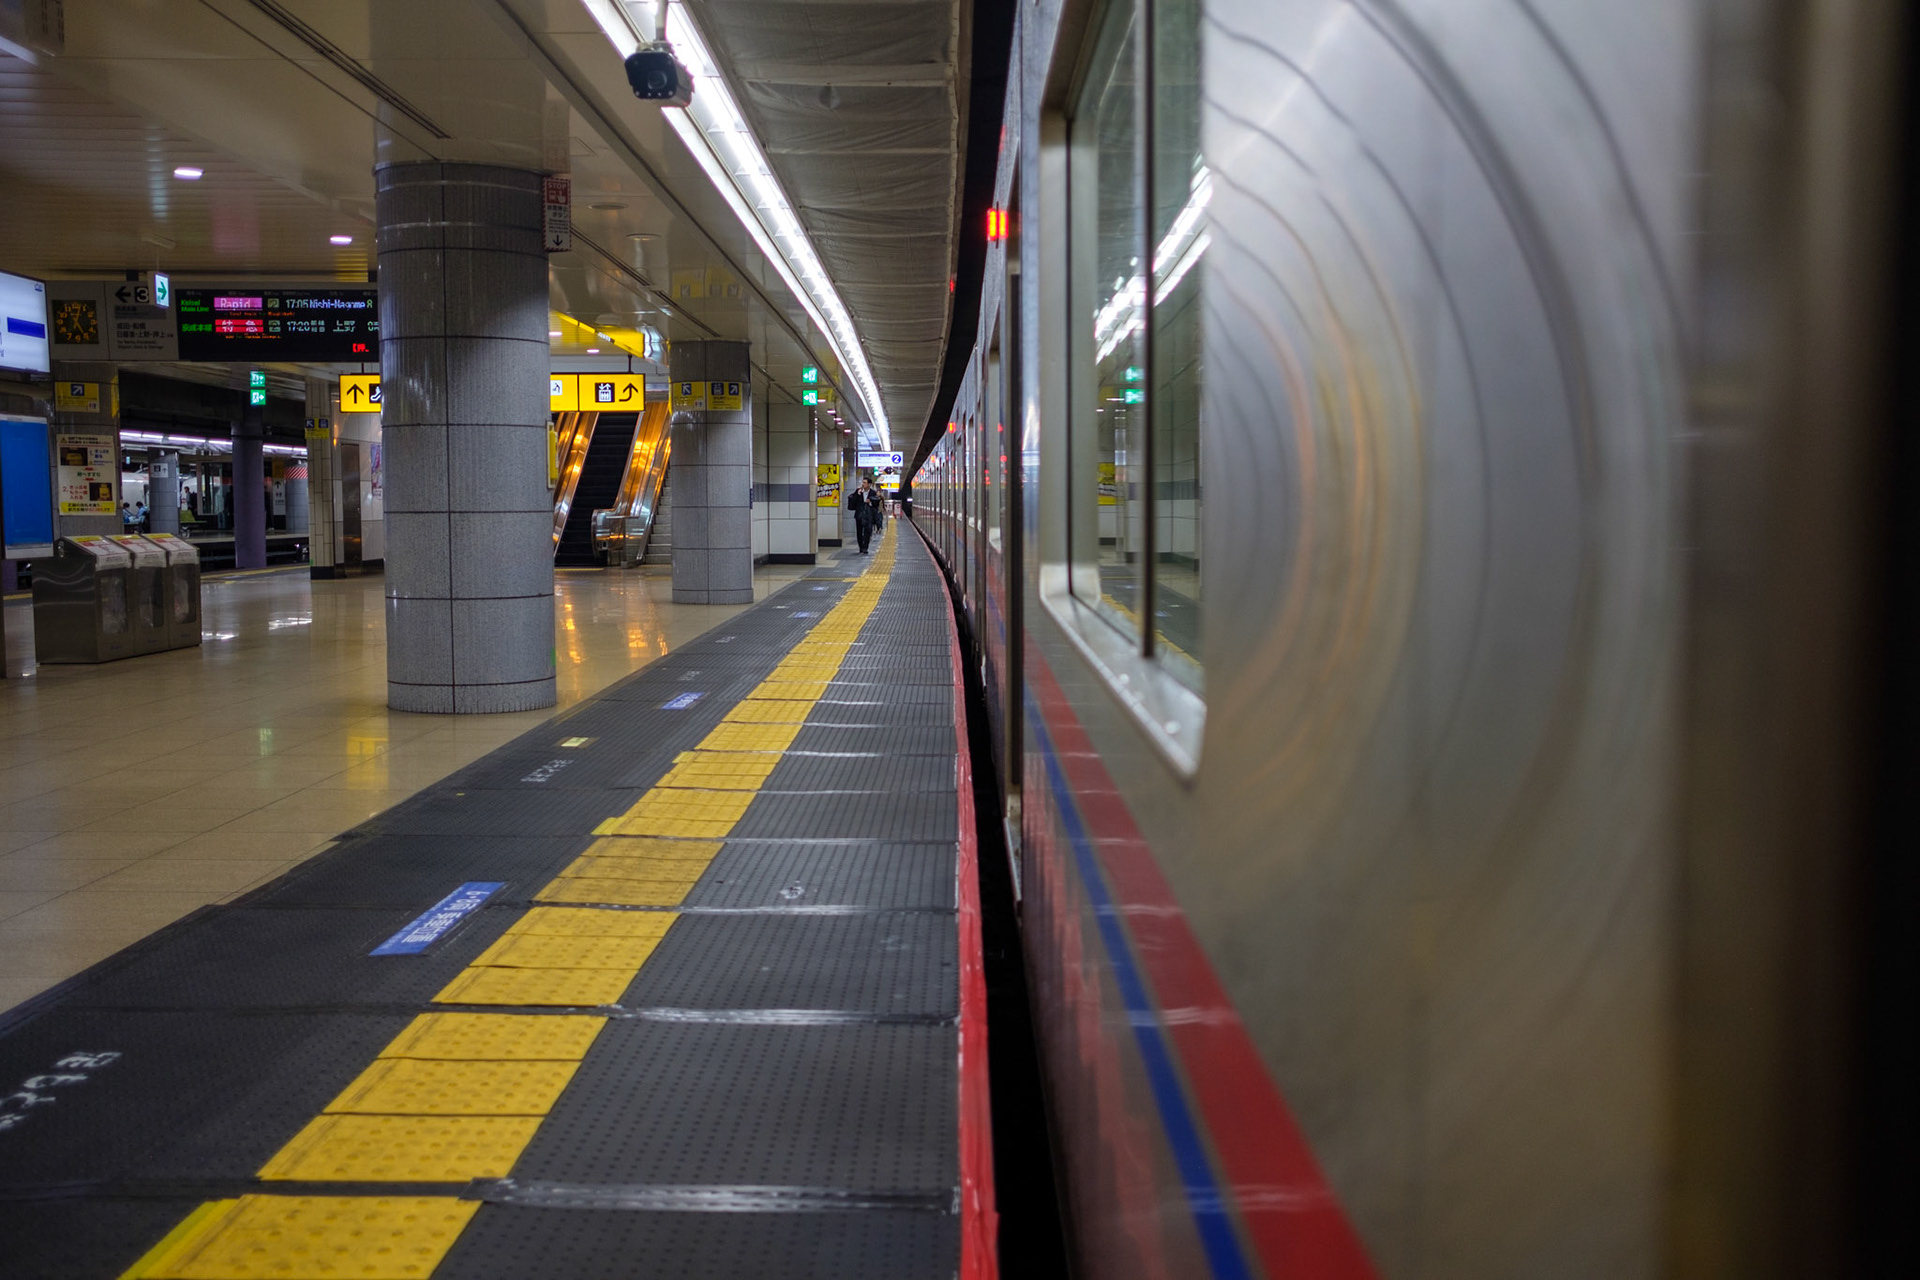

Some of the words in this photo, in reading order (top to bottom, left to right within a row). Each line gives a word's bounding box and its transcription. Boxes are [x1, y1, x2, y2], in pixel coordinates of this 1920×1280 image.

[547, 182, 567, 190] STOP
[136, 288, 149, 302] 3
[220, 298, 251, 311] Rapid
[286, 299, 308, 308] 17:05
[287, 321, 310, 332] 17:20
